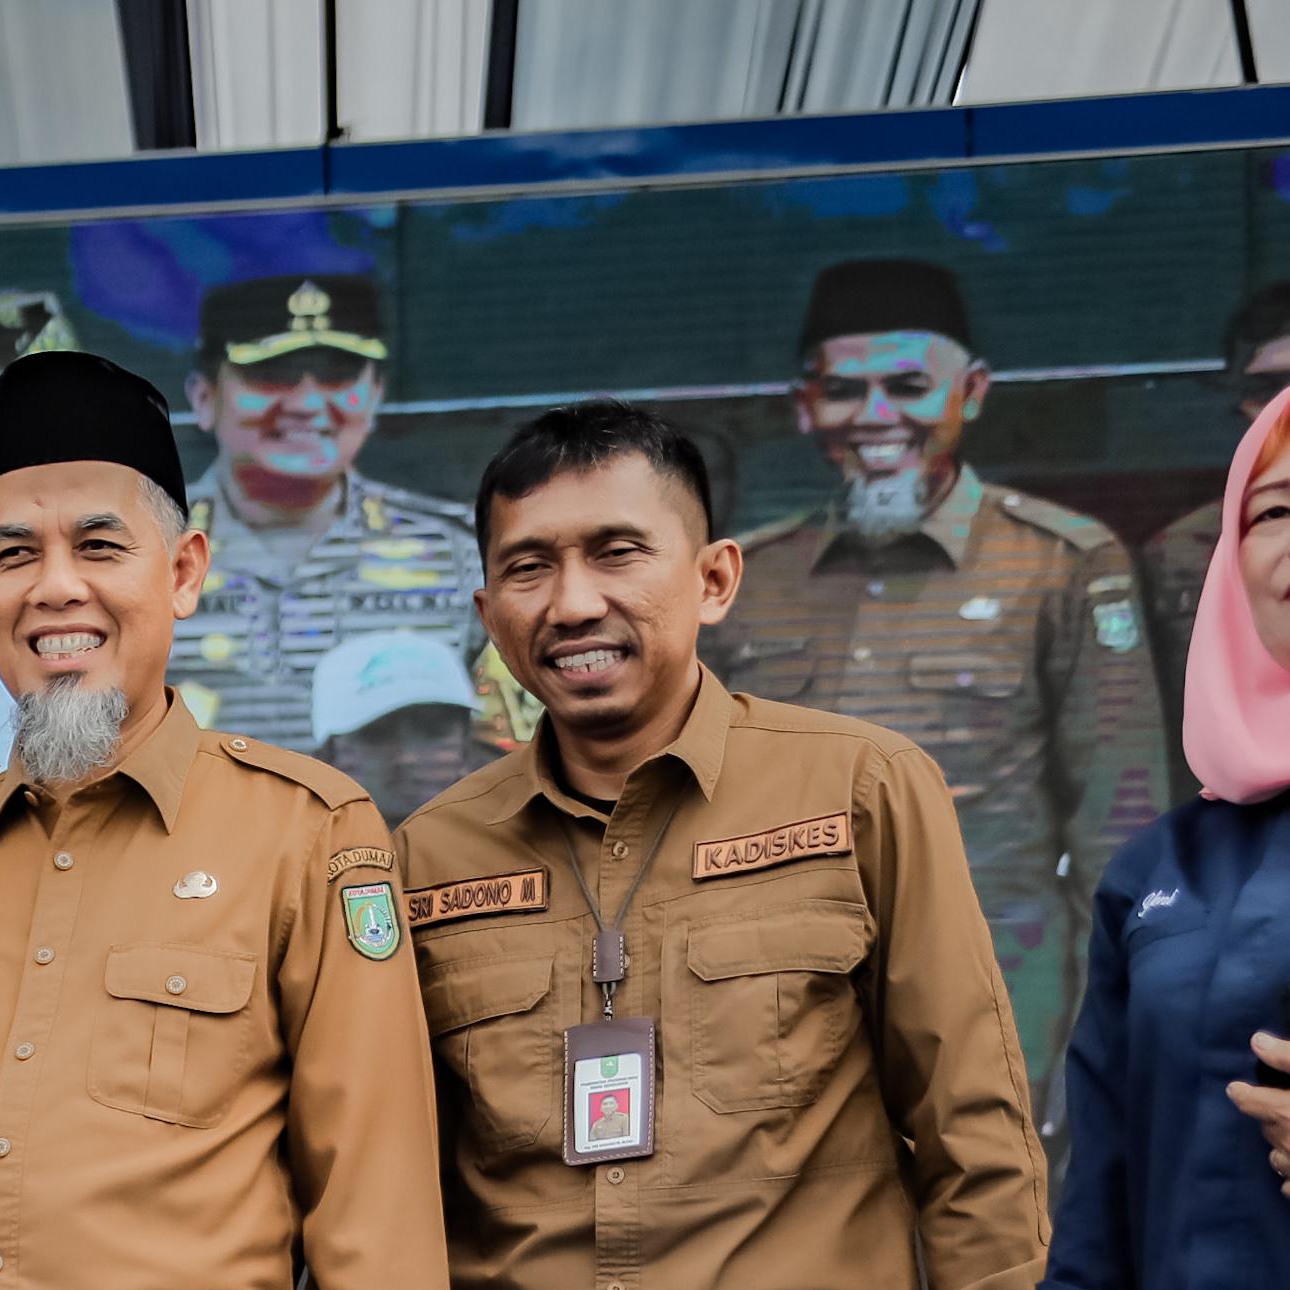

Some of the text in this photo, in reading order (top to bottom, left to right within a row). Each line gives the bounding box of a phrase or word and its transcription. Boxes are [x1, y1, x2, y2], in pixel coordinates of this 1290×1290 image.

[352, 849, 393, 868] DUMAI
[704, 823, 840, 871] KADISKES
[408, 894, 434, 921] SRI
[439, 879, 513, 914] SADONO
